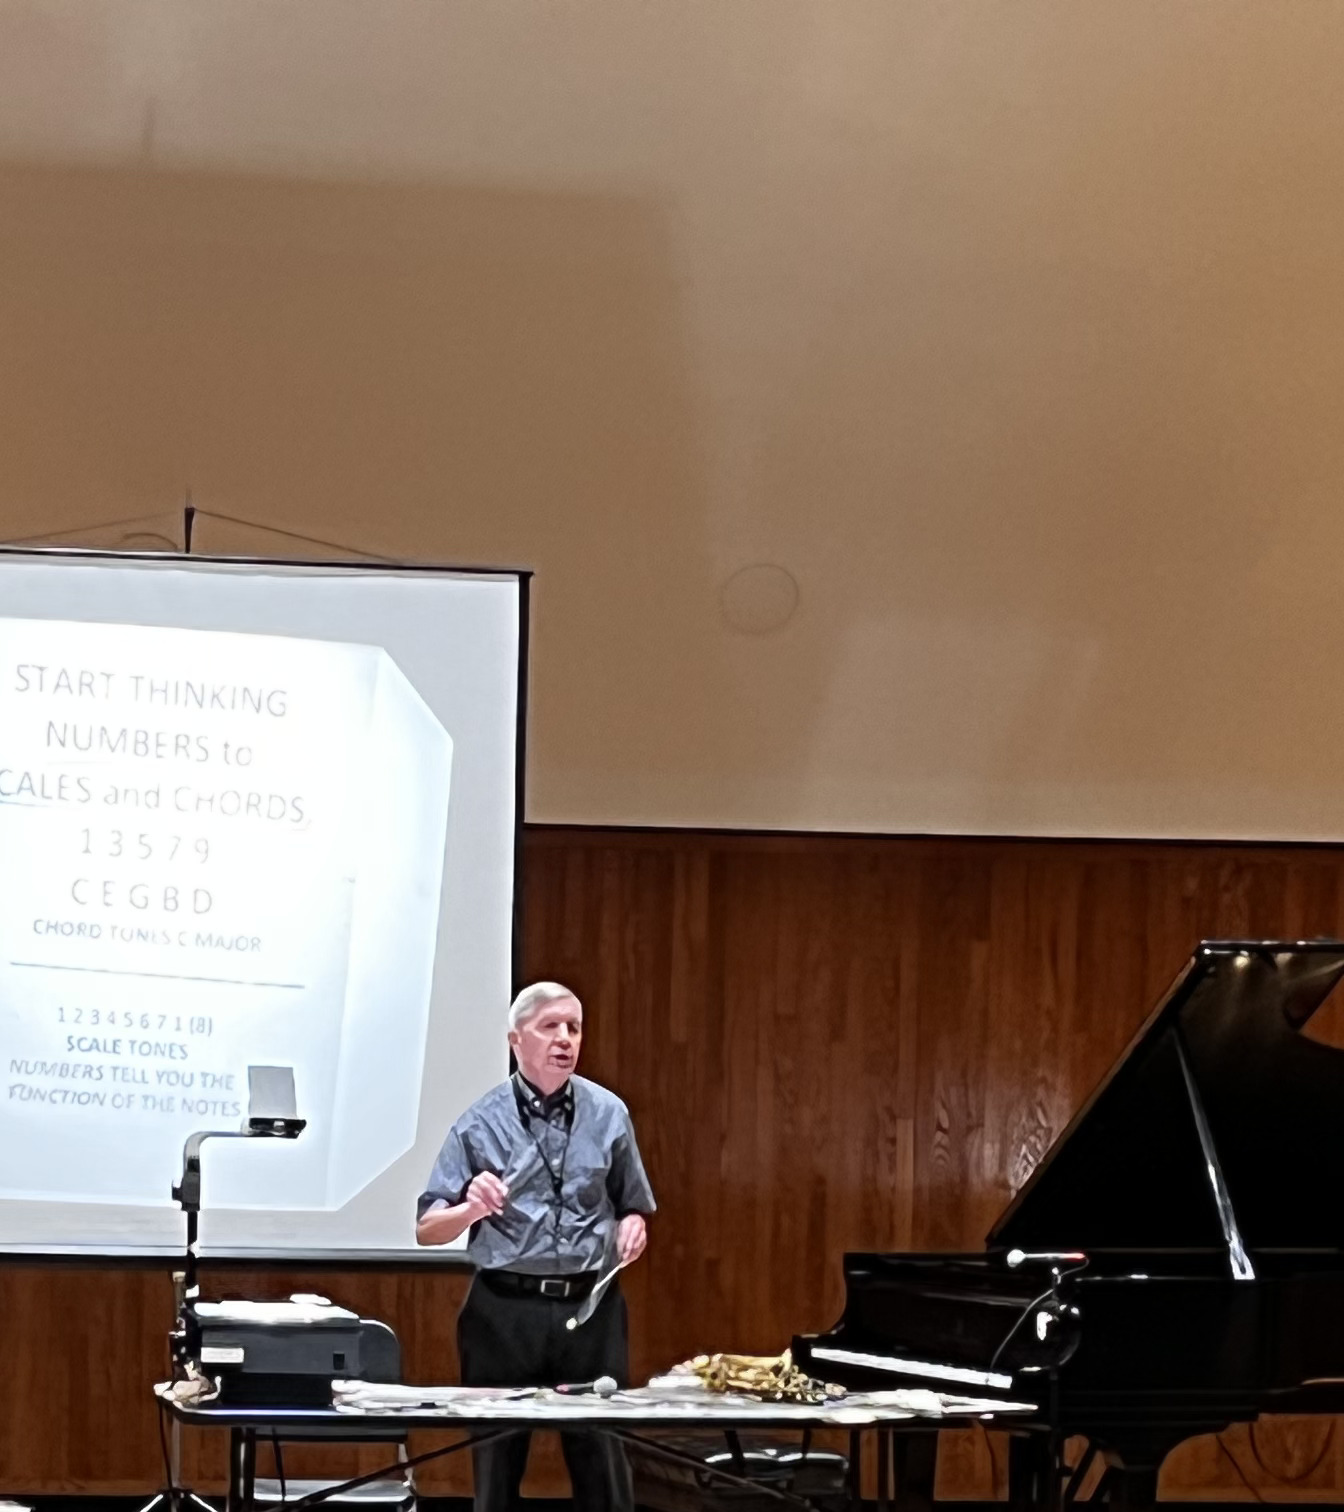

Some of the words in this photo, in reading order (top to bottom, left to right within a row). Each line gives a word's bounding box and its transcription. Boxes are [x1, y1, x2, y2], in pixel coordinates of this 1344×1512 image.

[14, 663, 116, 699] START
[129, 675, 288, 718] THINKING
[46, 720, 210, 762] NUMBERS
[222, 740, 254, 766] to
[102, 783, 161, 810] and
[81, 827, 93, 855] 1
[108, 829, 123, 857] 3
[137, 833, 153, 860] 5
[168, 836, 182, 861] 7
[194, 837, 210, 864] 9
[71, 877, 90, 906] C
[102, 880, 116, 907] E
[129, 883, 150, 910] G
[162, 886, 179, 912] B
[193, 888, 213, 914] D
[32, 918, 102, 940] CHORD
[194, 932, 263, 953] MAJOR
[57, 1006, 66, 1023] 1
[73, 1007, 84, 1024] 2
[90, 1008, 101, 1025] 3
[106, 1010, 116, 1026] 4
[123, 1011, 134, 1028] 5
[139, 1013, 150, 1030] 6
[157, 1014, 167, 1031] 7
[173, 1015, 182, 1032] 1
[66, 1034, 122, 1055] SCALE
[128, 1039, 189, 1061] TONES
[9, 1059, 105, 1081] NUMBERS
[109, 1066, 150, 1085] TELL
[155, 1069, 195, 1089] YOU
[200, 1071, 236, 1091] THE
[8, 1083, 108, 1107] FUNCTION
[111, 1092, 136, 1110] OF
[141, 1095, 176, 1113] THE
[180, 1098, 241, 1117] NOTES
